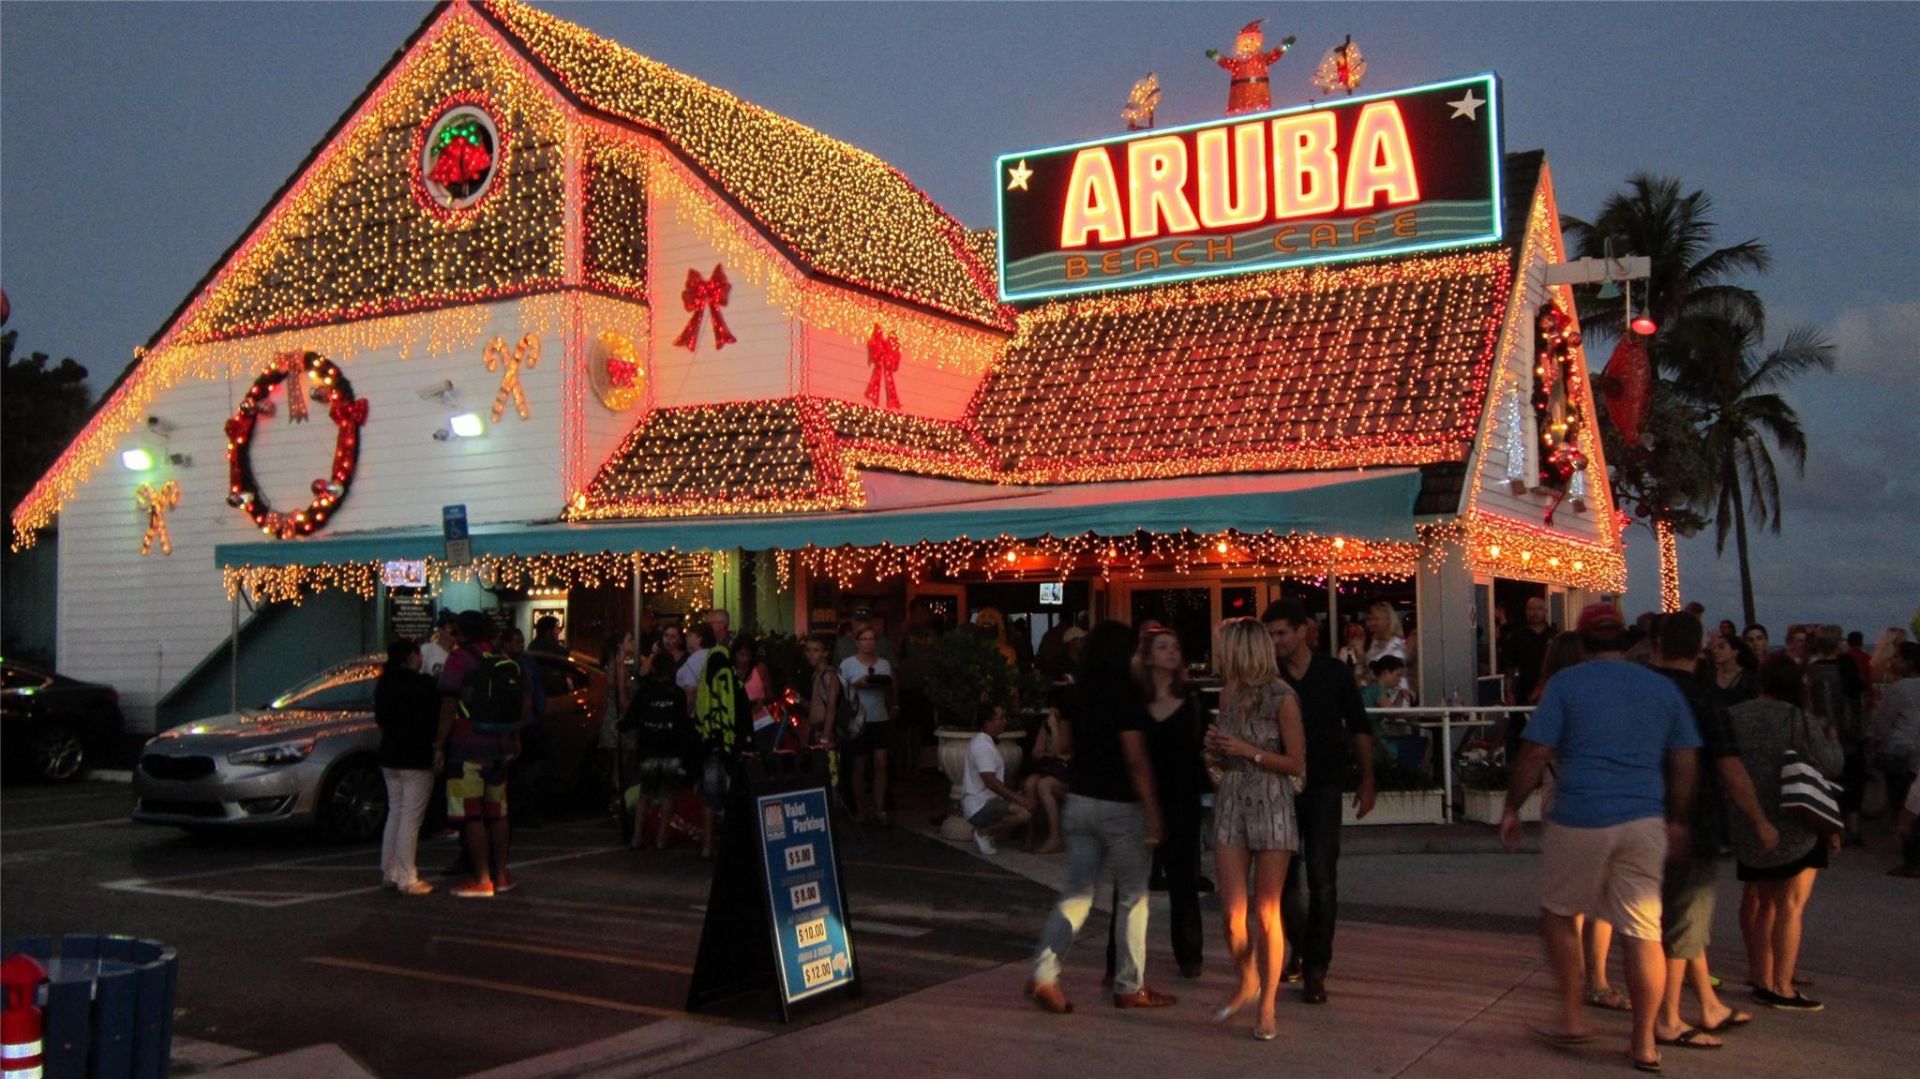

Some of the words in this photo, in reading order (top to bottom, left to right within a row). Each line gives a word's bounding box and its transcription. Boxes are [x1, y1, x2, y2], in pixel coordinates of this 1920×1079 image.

[1060, 100, 1420, 248] ARUBA
[1065, 237, 1234, 281] BEACH
[1273, 211, 1417, 253] CAFE
[784, 802, 807, 818] Valet
[792, 816, 826, 834] Parking
